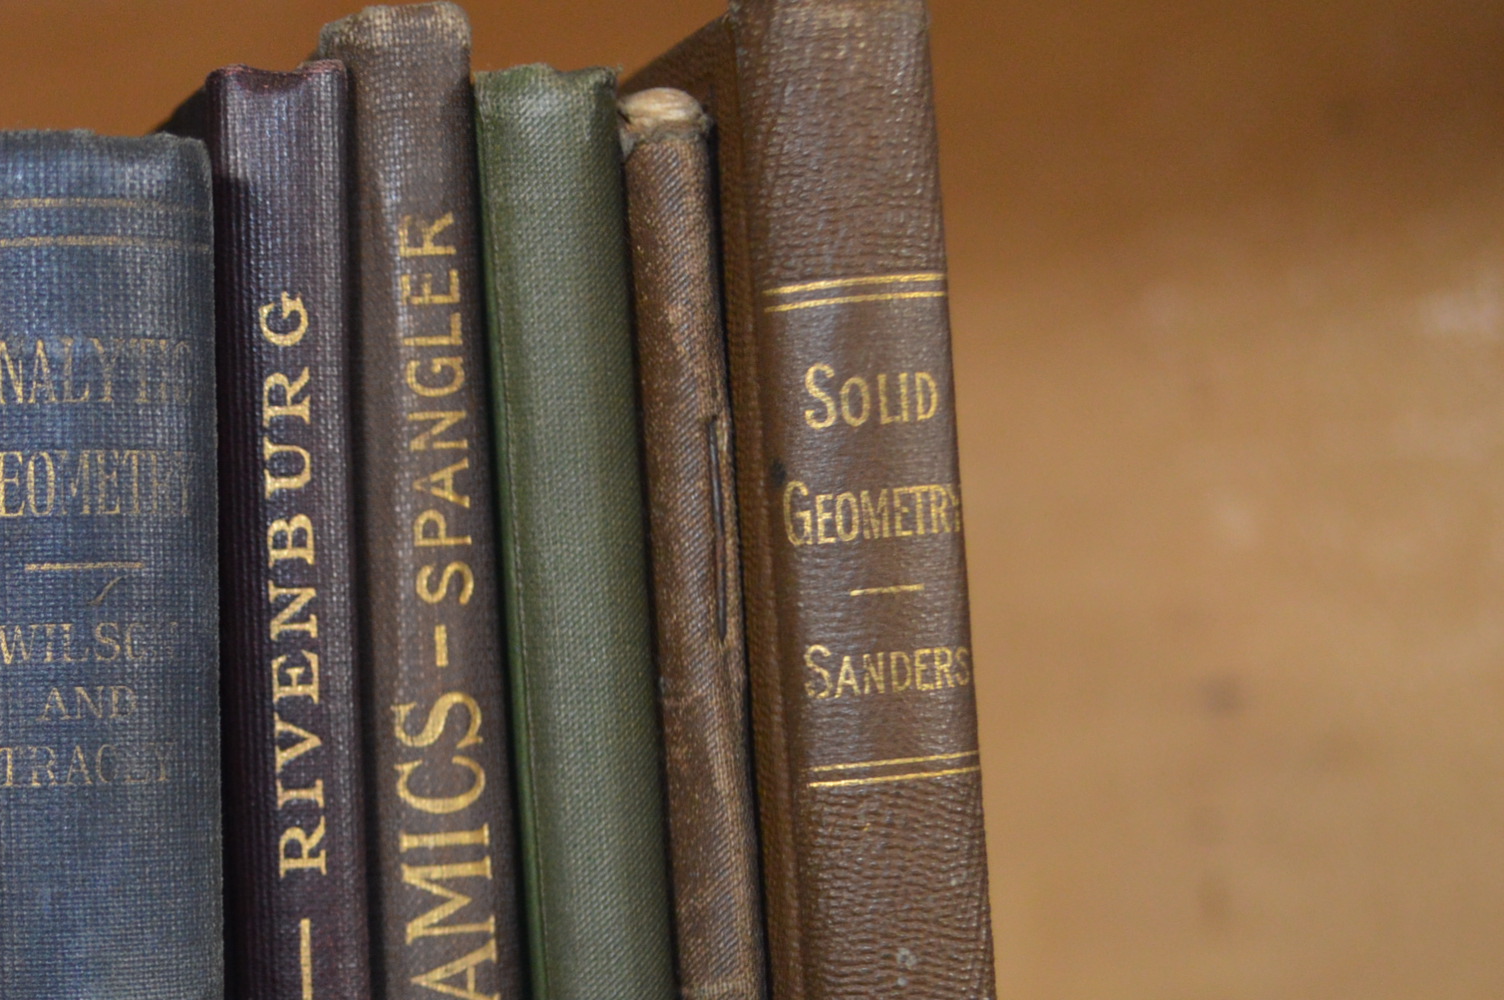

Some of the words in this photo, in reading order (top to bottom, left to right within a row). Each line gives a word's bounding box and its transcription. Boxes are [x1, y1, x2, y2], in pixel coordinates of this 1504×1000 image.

[398, 211, 475, 605] SPANGLER
[805, 362, 938, 430] SOLID
[783, 481, 962, 546] GEOMETRY
[258, 291, 327, 879] RIVENBURG
[35, 685, 137, 722] AND
[804, 645, 970, 699] SANDERS
